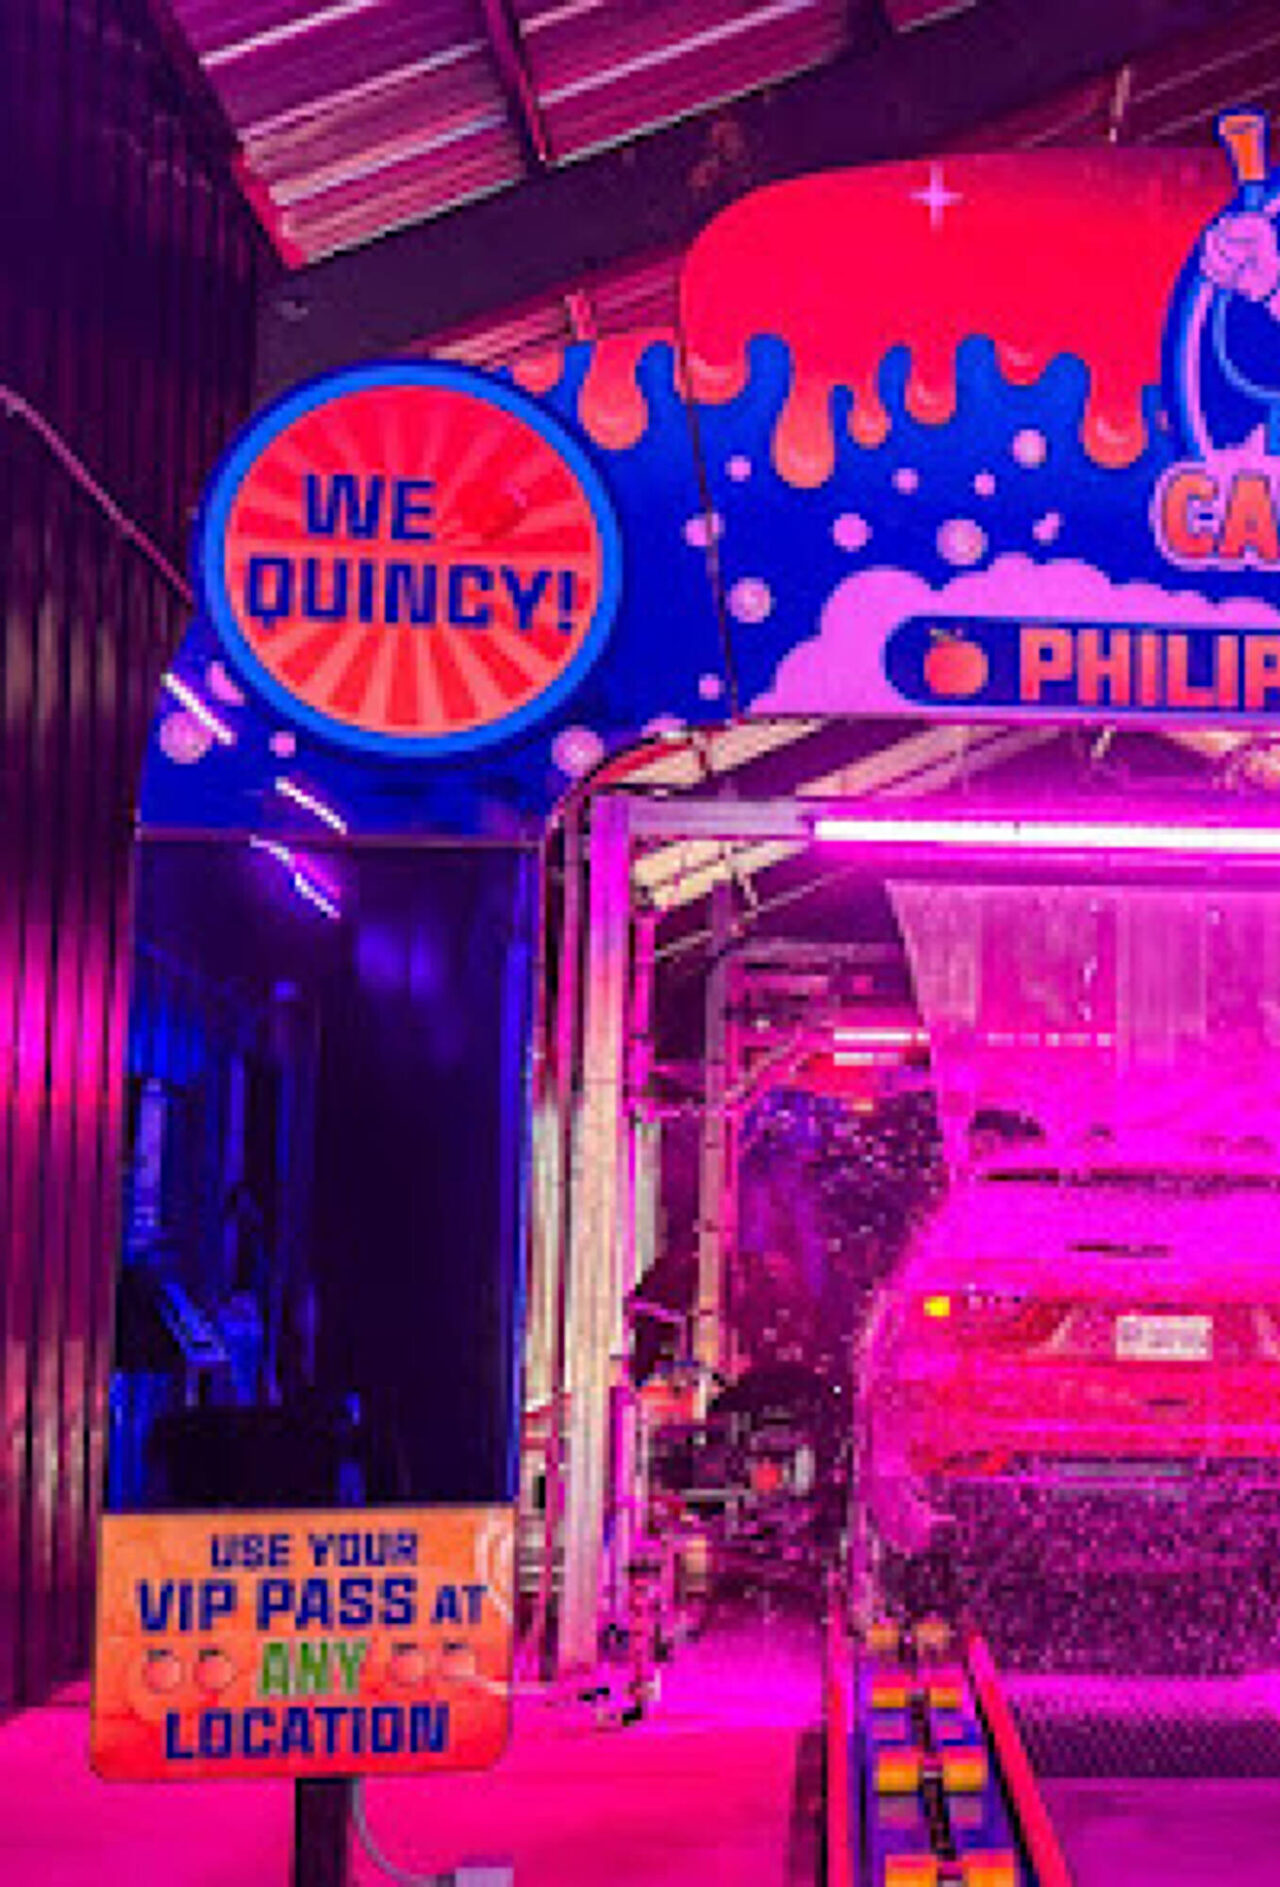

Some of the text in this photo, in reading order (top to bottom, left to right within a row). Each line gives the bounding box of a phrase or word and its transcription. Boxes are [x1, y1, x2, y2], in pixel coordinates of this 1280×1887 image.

[305, 474, 434, 541] WE
[249, 556, 577, 632] QUINCY!
[209, 1530, 419, 1569] USE YOUR
[136, 1577, 487, 1631] VIP PASS AT
[257, 1640, 368, 1696] ANY
[165, 1703, 450, 1760] LOCATION
